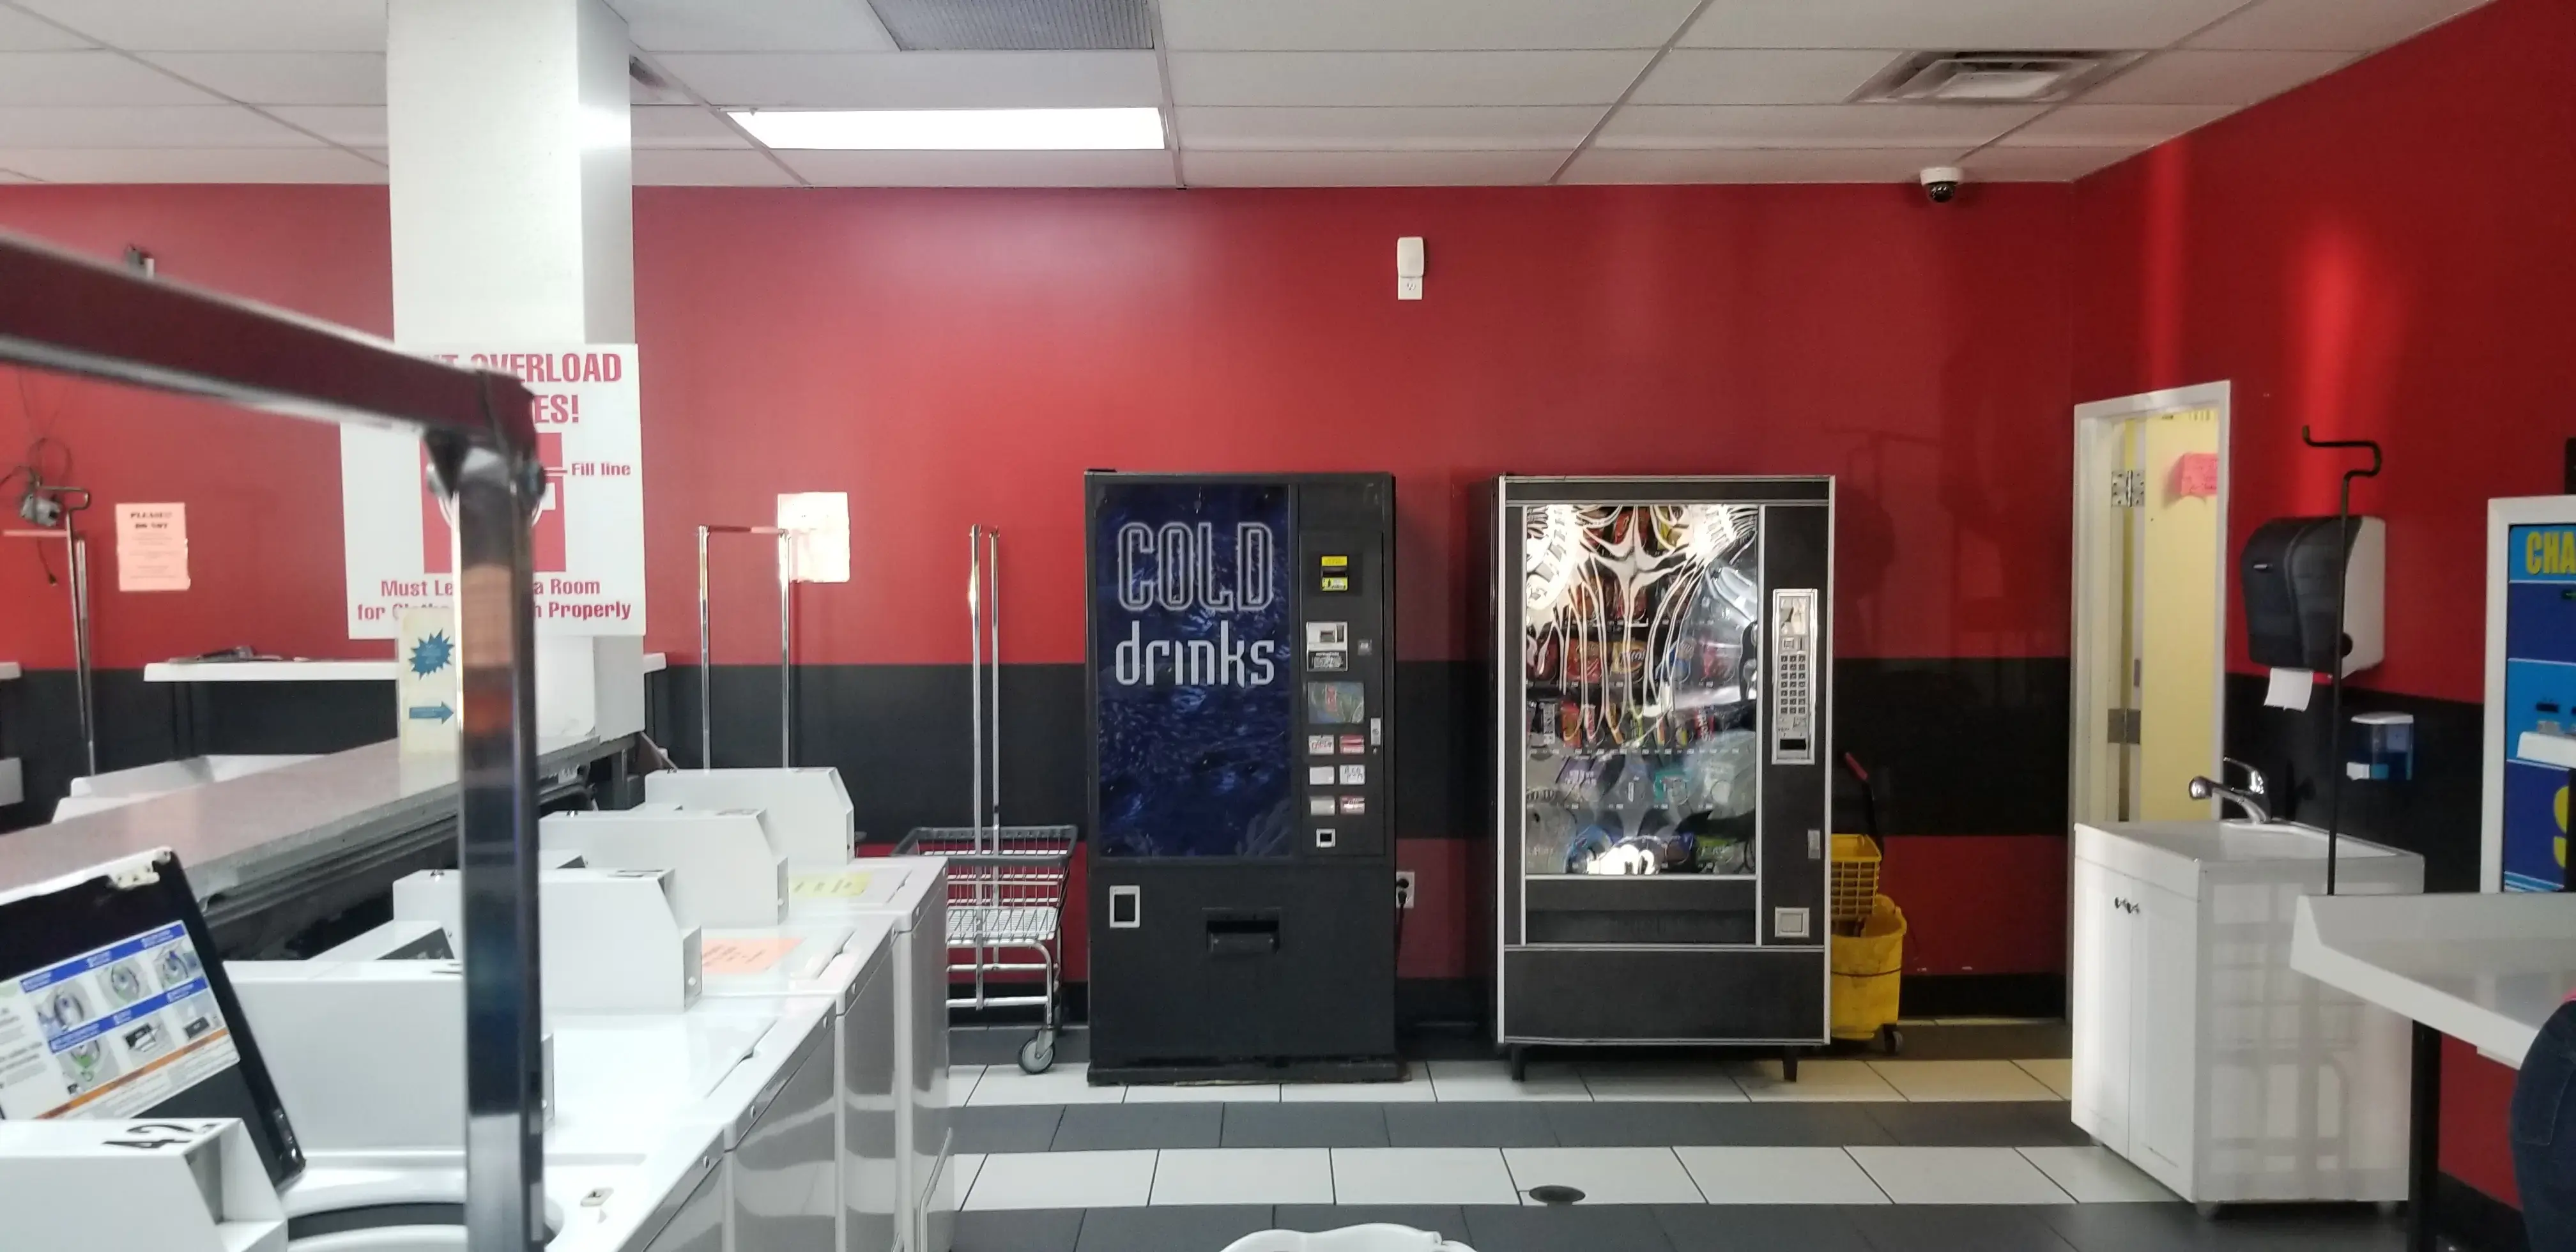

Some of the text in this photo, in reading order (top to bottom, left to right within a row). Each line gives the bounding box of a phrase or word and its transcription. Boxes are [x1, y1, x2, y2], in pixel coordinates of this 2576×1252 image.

[571, 462, 631, 477] Fill line
[1118, 522, 1273, 611] COLD
[381, 580, 427, 596] Must
[551, 579, 600, 595] Room
[358, 603, 385, 620] for
[549, 601, 631, 620] Properly
[1116, 620, 1275, 688] drinks
[102, 1123, 220, 1149] 42
